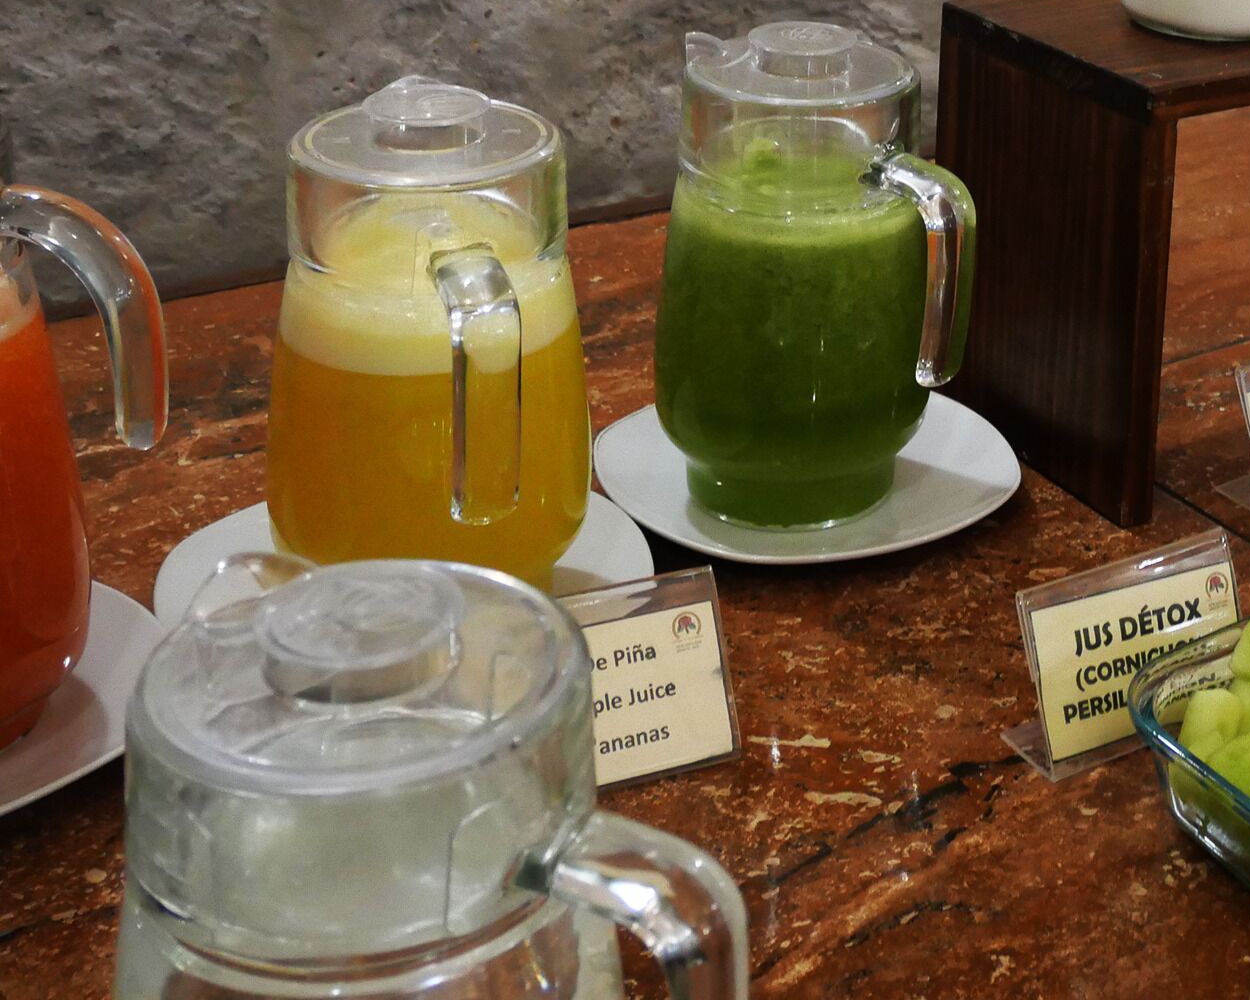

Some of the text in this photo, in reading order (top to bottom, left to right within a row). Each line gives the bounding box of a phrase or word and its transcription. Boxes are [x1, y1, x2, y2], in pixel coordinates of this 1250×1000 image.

[1074, 597, 1202, 657] JUS DÉTOX
[613, 644, 656, 667] Piña
[628, 681, 676, 706] Juice
